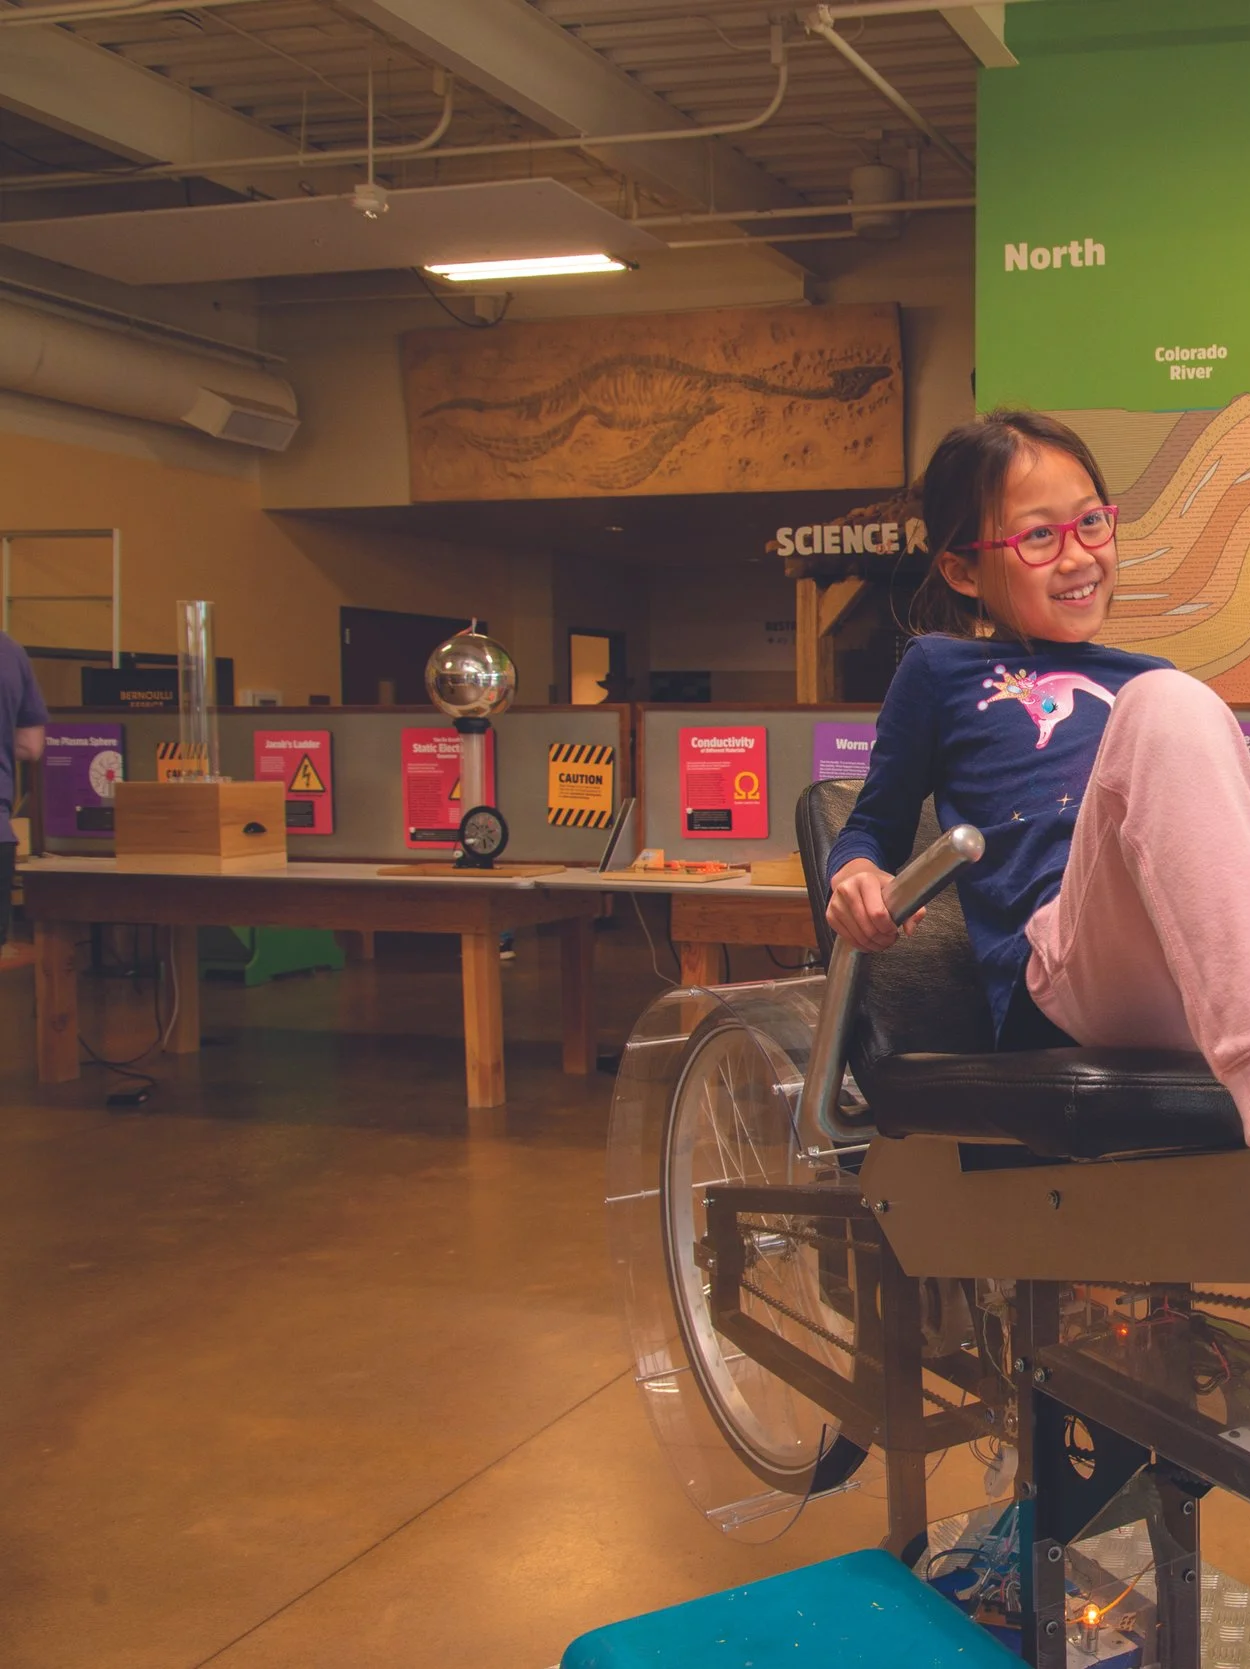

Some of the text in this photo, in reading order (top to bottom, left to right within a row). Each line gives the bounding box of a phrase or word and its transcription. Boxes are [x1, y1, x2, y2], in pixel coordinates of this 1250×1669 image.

[1004, 238, 1106, 272] North
[1154, 344, 1228, 362] Colorado
[1169, 365, 1213, 380] River
[776, 522, 900, 557] SCIENCE
[60, 737, 88, 746] Plasma
[88, 737, 118, 747] Sphere
[412, 743, 437, 753] Static
[691, 736, 755, 749] Conductivity
[836, 738, 868, 750] Worm
[558, 773, 603, 785] CAUTION
